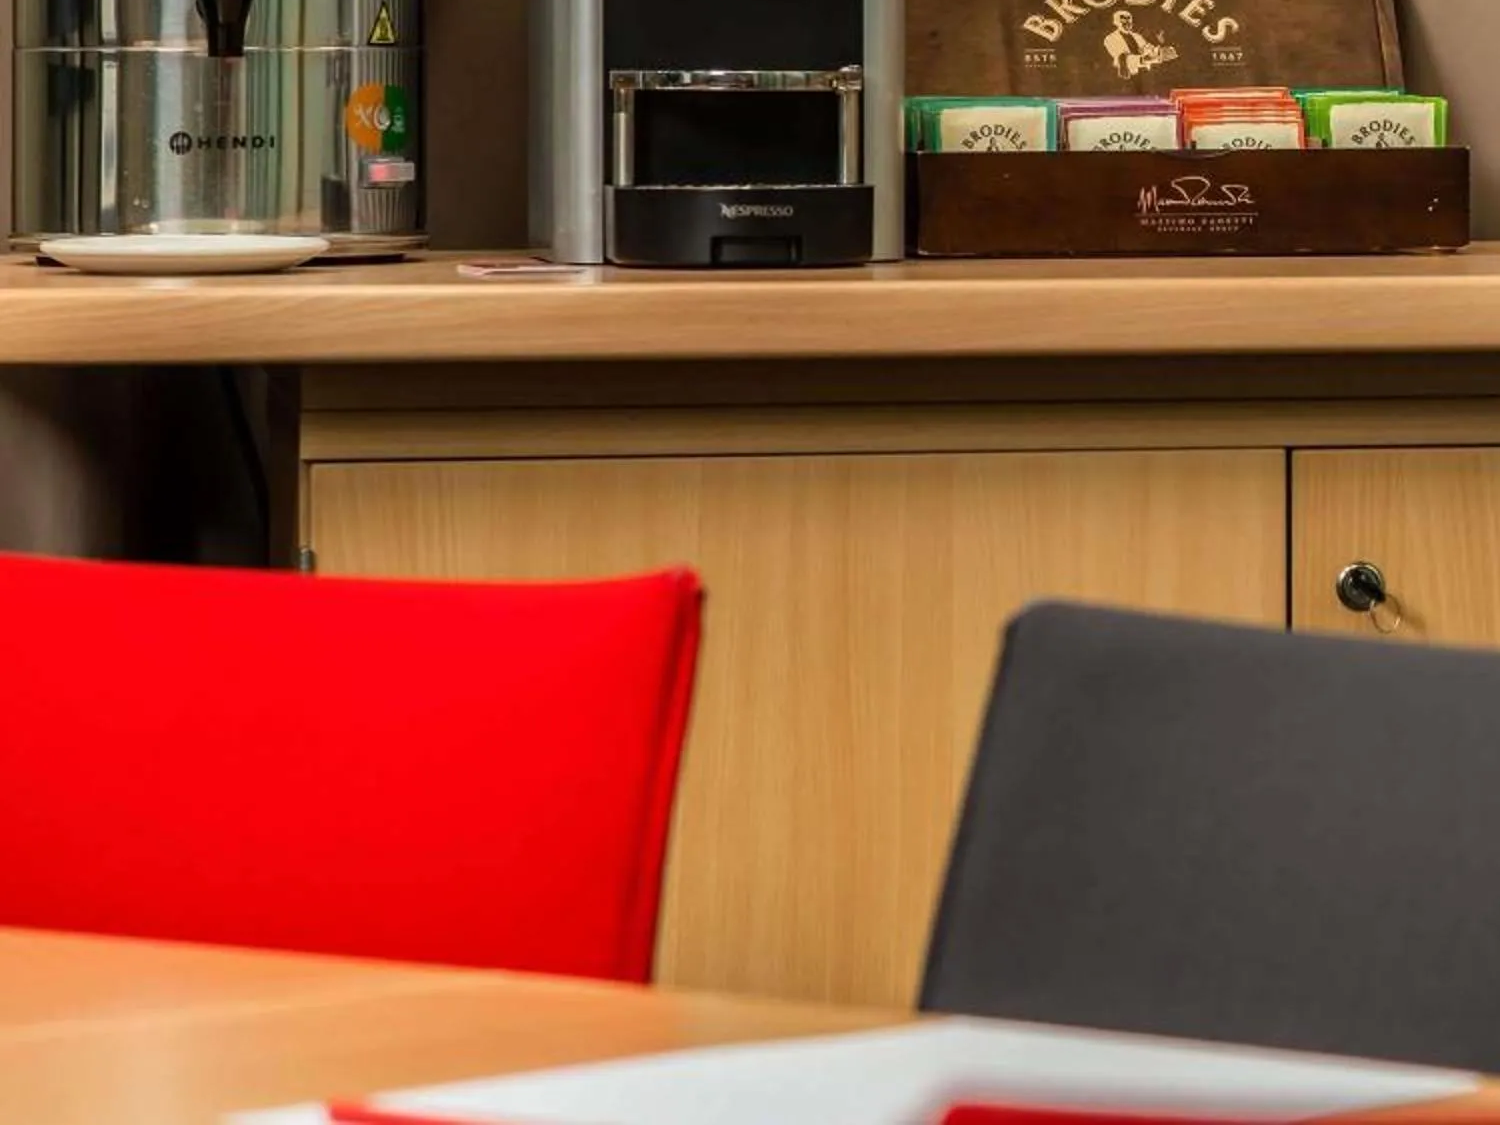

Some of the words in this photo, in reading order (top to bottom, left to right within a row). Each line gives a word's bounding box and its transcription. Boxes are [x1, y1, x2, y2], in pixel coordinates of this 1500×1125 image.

[197, 135, 275, 150] HENDI
[961, 124, 1027, 150] BRODIES
[1351, 119, 1416, 146] BRODIES
[717, 202, 794, 220] NESPRESSO
